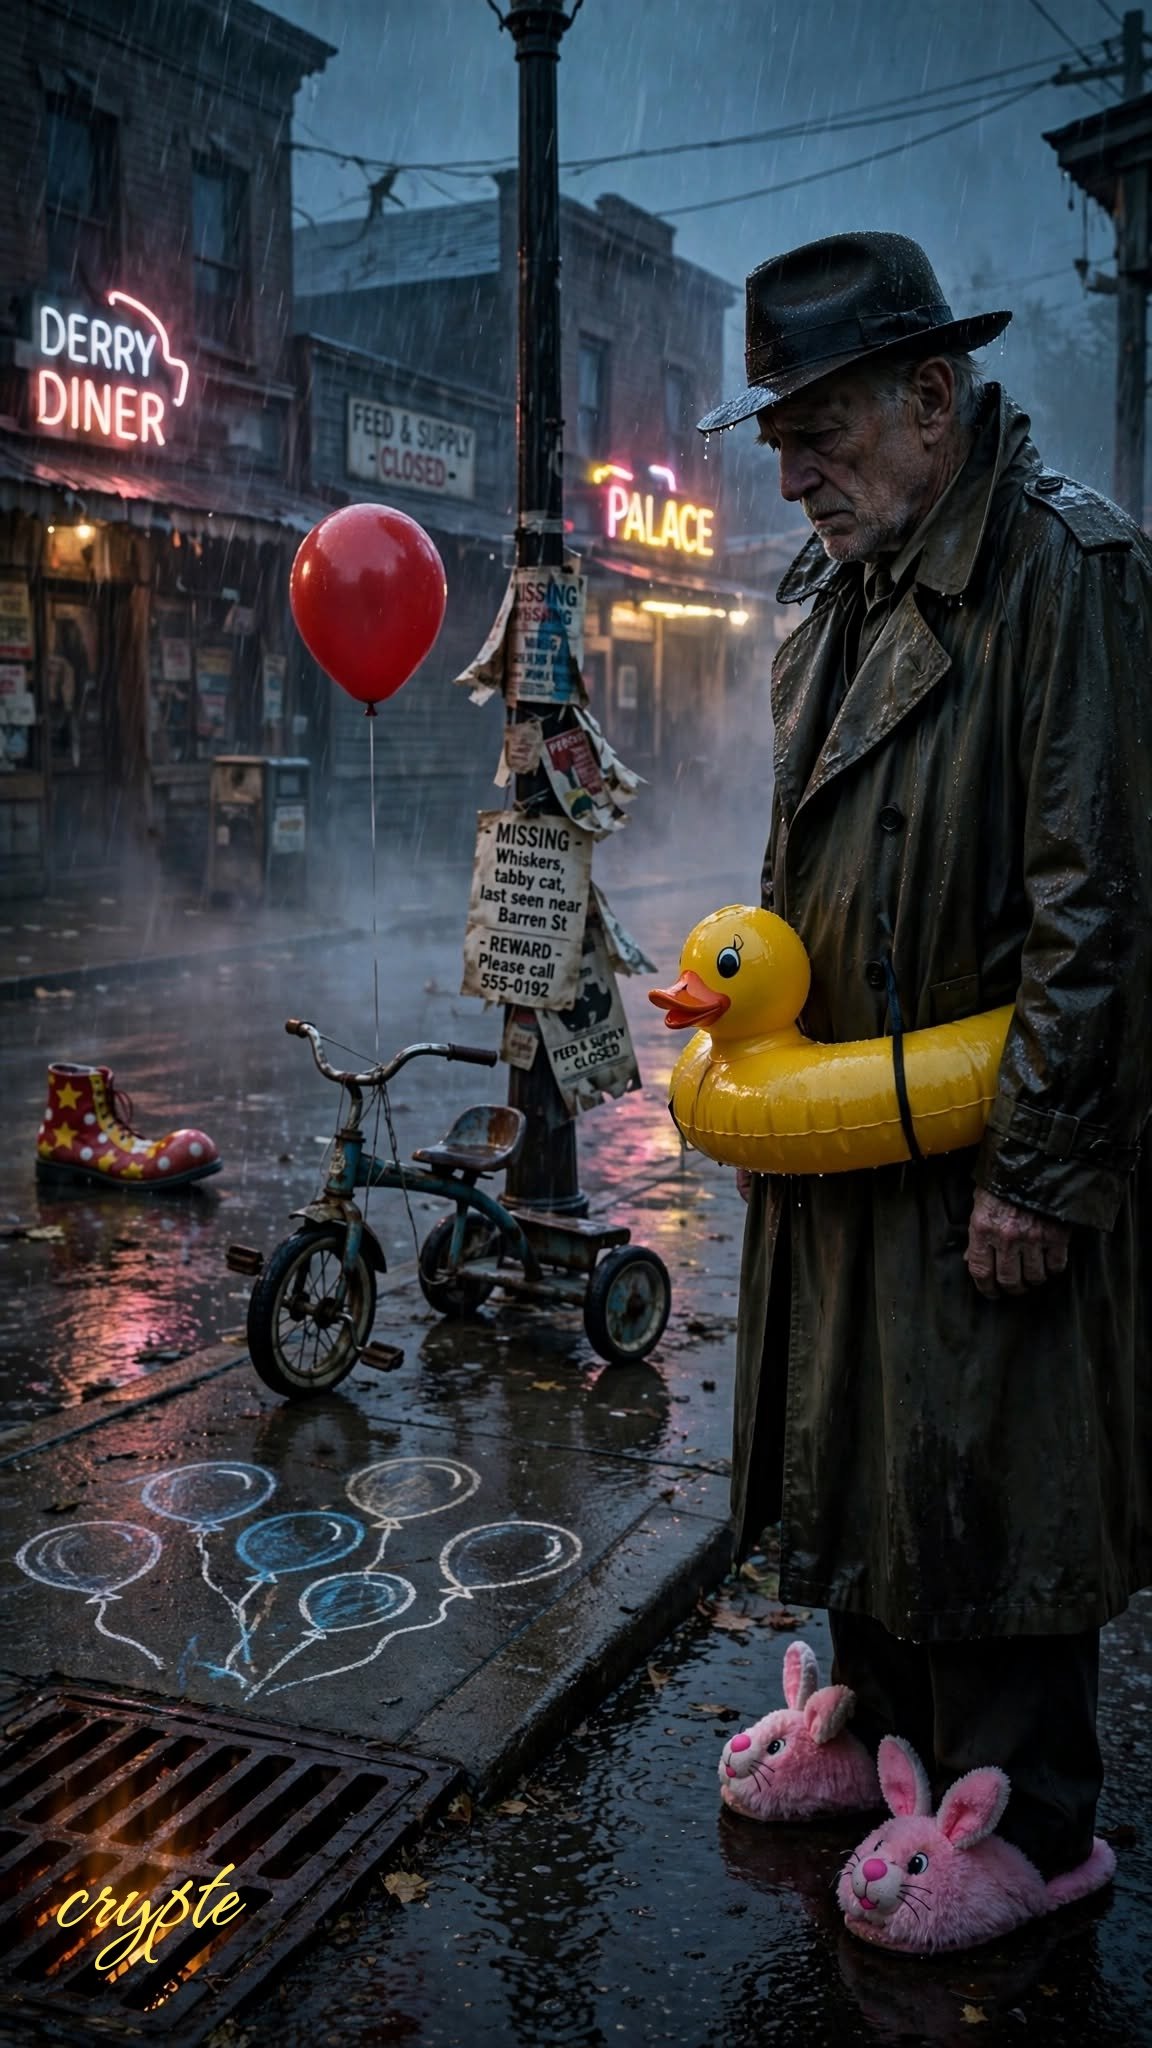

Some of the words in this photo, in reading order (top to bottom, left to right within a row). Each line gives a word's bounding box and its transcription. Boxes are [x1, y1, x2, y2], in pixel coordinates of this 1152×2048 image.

[40, 305, 157, 377] DERRY
[37, 369, 165, 446] DINER
[353, 402, 394, 439] FEED
[401, 415, 411, 444] &
[418, 420, 473, 459] SUPPLY
[381, 445, 445, 488] CLOSED
[607, 484, 714, 557] PALACE
[496, 822, 570, 852] MISSING
[496, 847, 565, 875] Whiskers,
[494, 868, 535, 891] tabby
[539, 876, 565, 895] cat,
[480, 884, 507, 904] last
[510, 892, 543, 909] seen
[549, 897, 582, 913] near
[498, 906, 546, 928] Barren
[551, 914, 567, 932] St
[489, 935, 552, 960] REWARD
[478, 953, 525, 975] Please
[529, 962, 555, 979] call
[481, 973, 549, 998] 555-0192
[552, 1044, 578, 1063] FEED
[590, 1026, 625, 1048] SUPPLY
[574, 1043, 620, 1069] CLOSED
